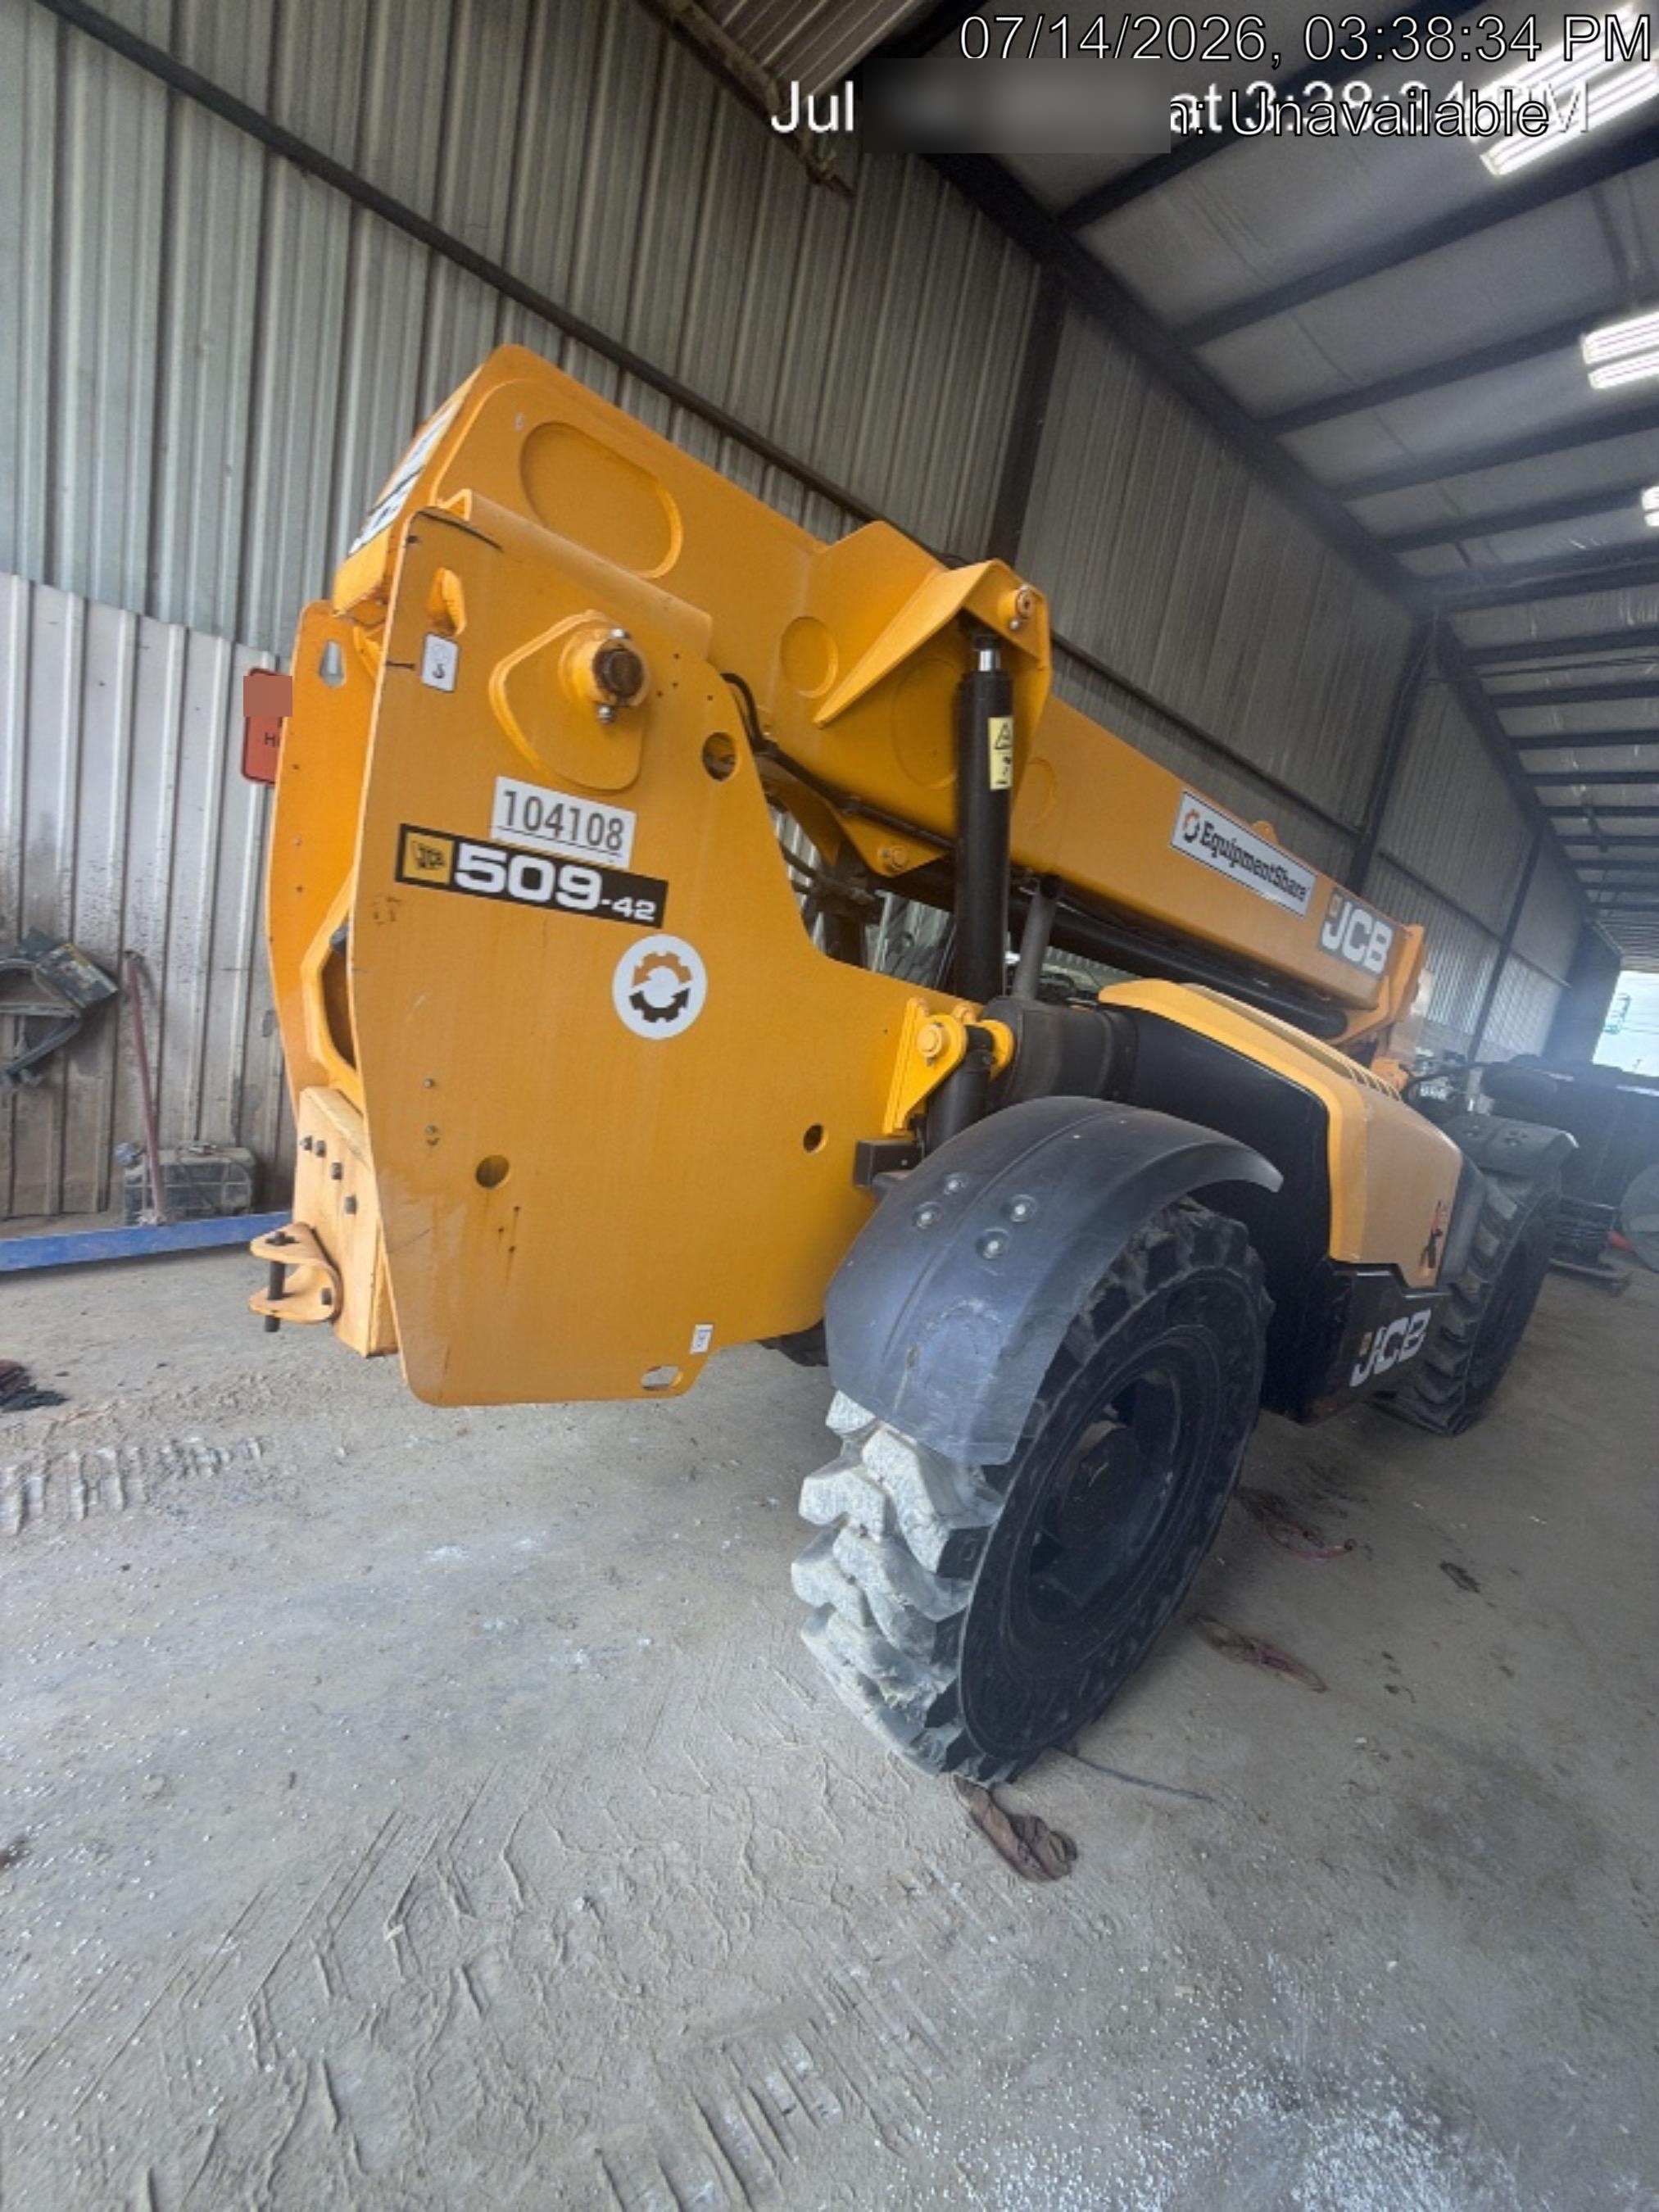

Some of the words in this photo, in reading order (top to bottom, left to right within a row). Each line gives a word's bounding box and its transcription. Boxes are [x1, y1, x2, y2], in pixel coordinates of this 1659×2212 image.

[503, 790, 623, 852] 104108
[454, 841, 655, 922] 509-42
[1199, 820, 1309, 902] EquipmentShare
[1321, 898, 1393, 974] JCB
[1349, 1309, 1431, 1387] JCB
